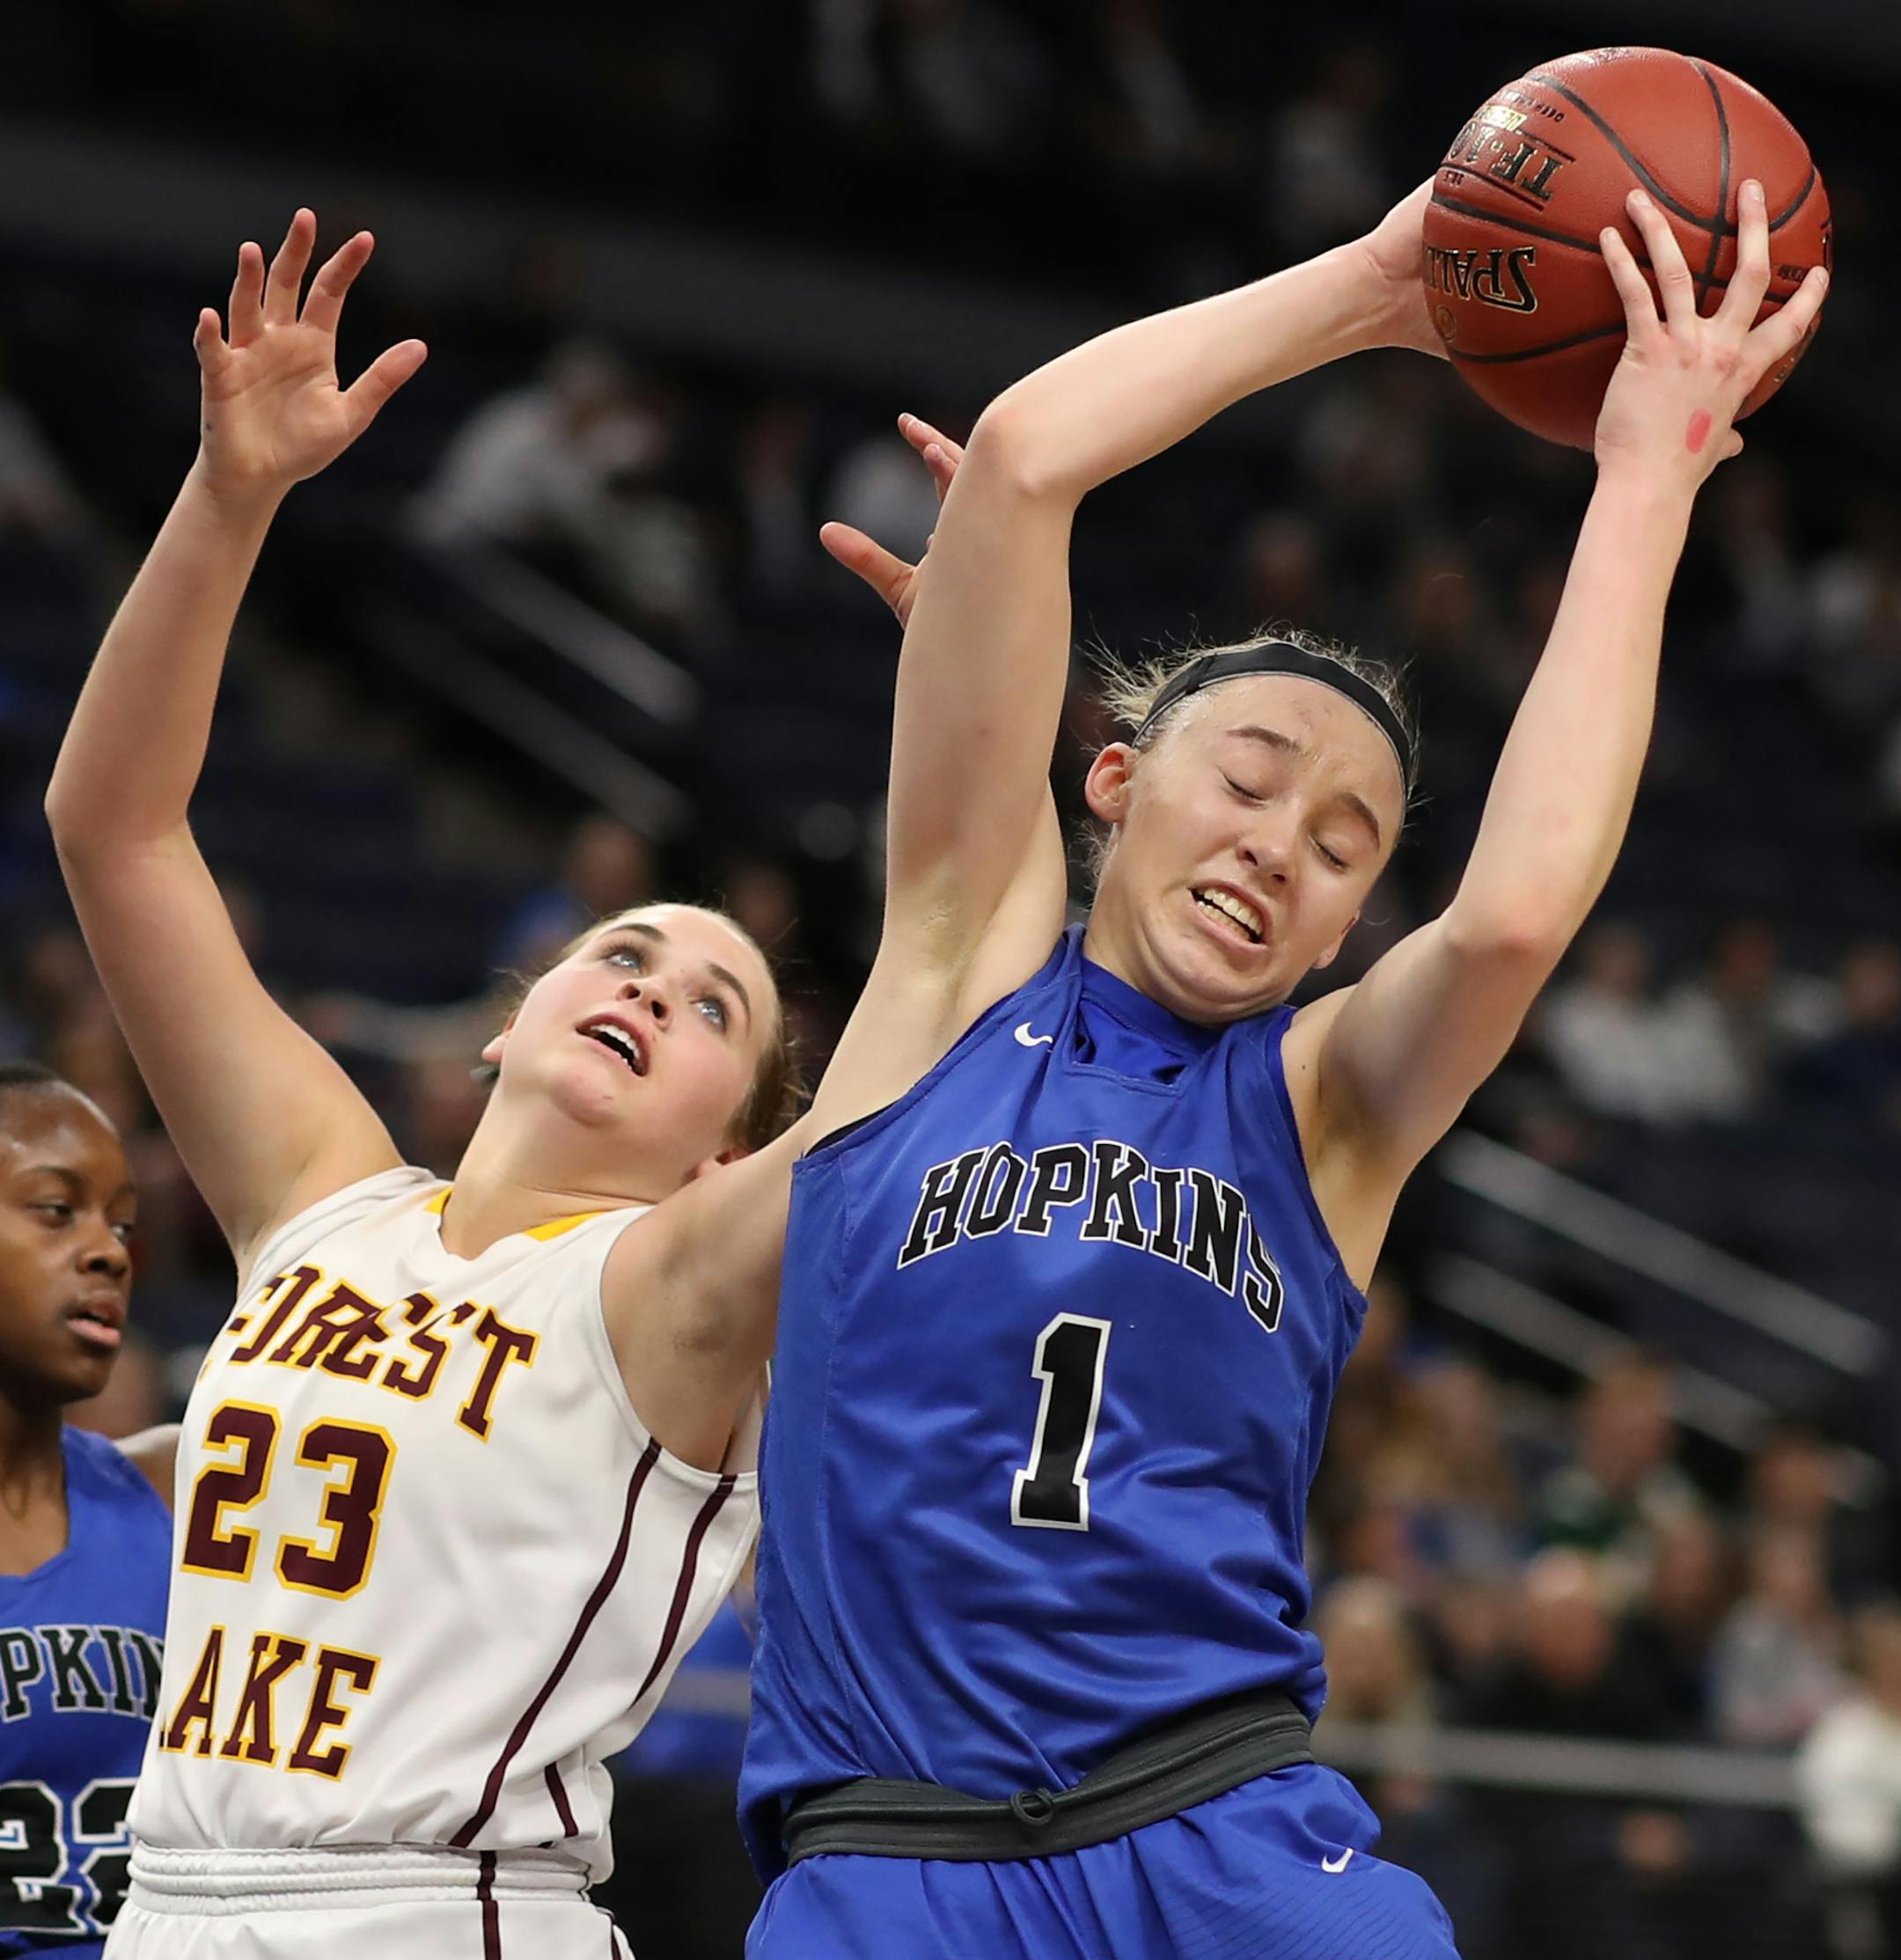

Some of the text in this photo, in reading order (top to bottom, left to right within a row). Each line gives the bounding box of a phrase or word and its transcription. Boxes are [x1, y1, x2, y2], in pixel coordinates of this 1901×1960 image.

[896, 1139, 1285, 1333] HOPKINS
[180, 1398, 398, 1602] 23
[1010, 1311, 1112, 1531] 1
[158, 1625, 382, 1783] AKE
